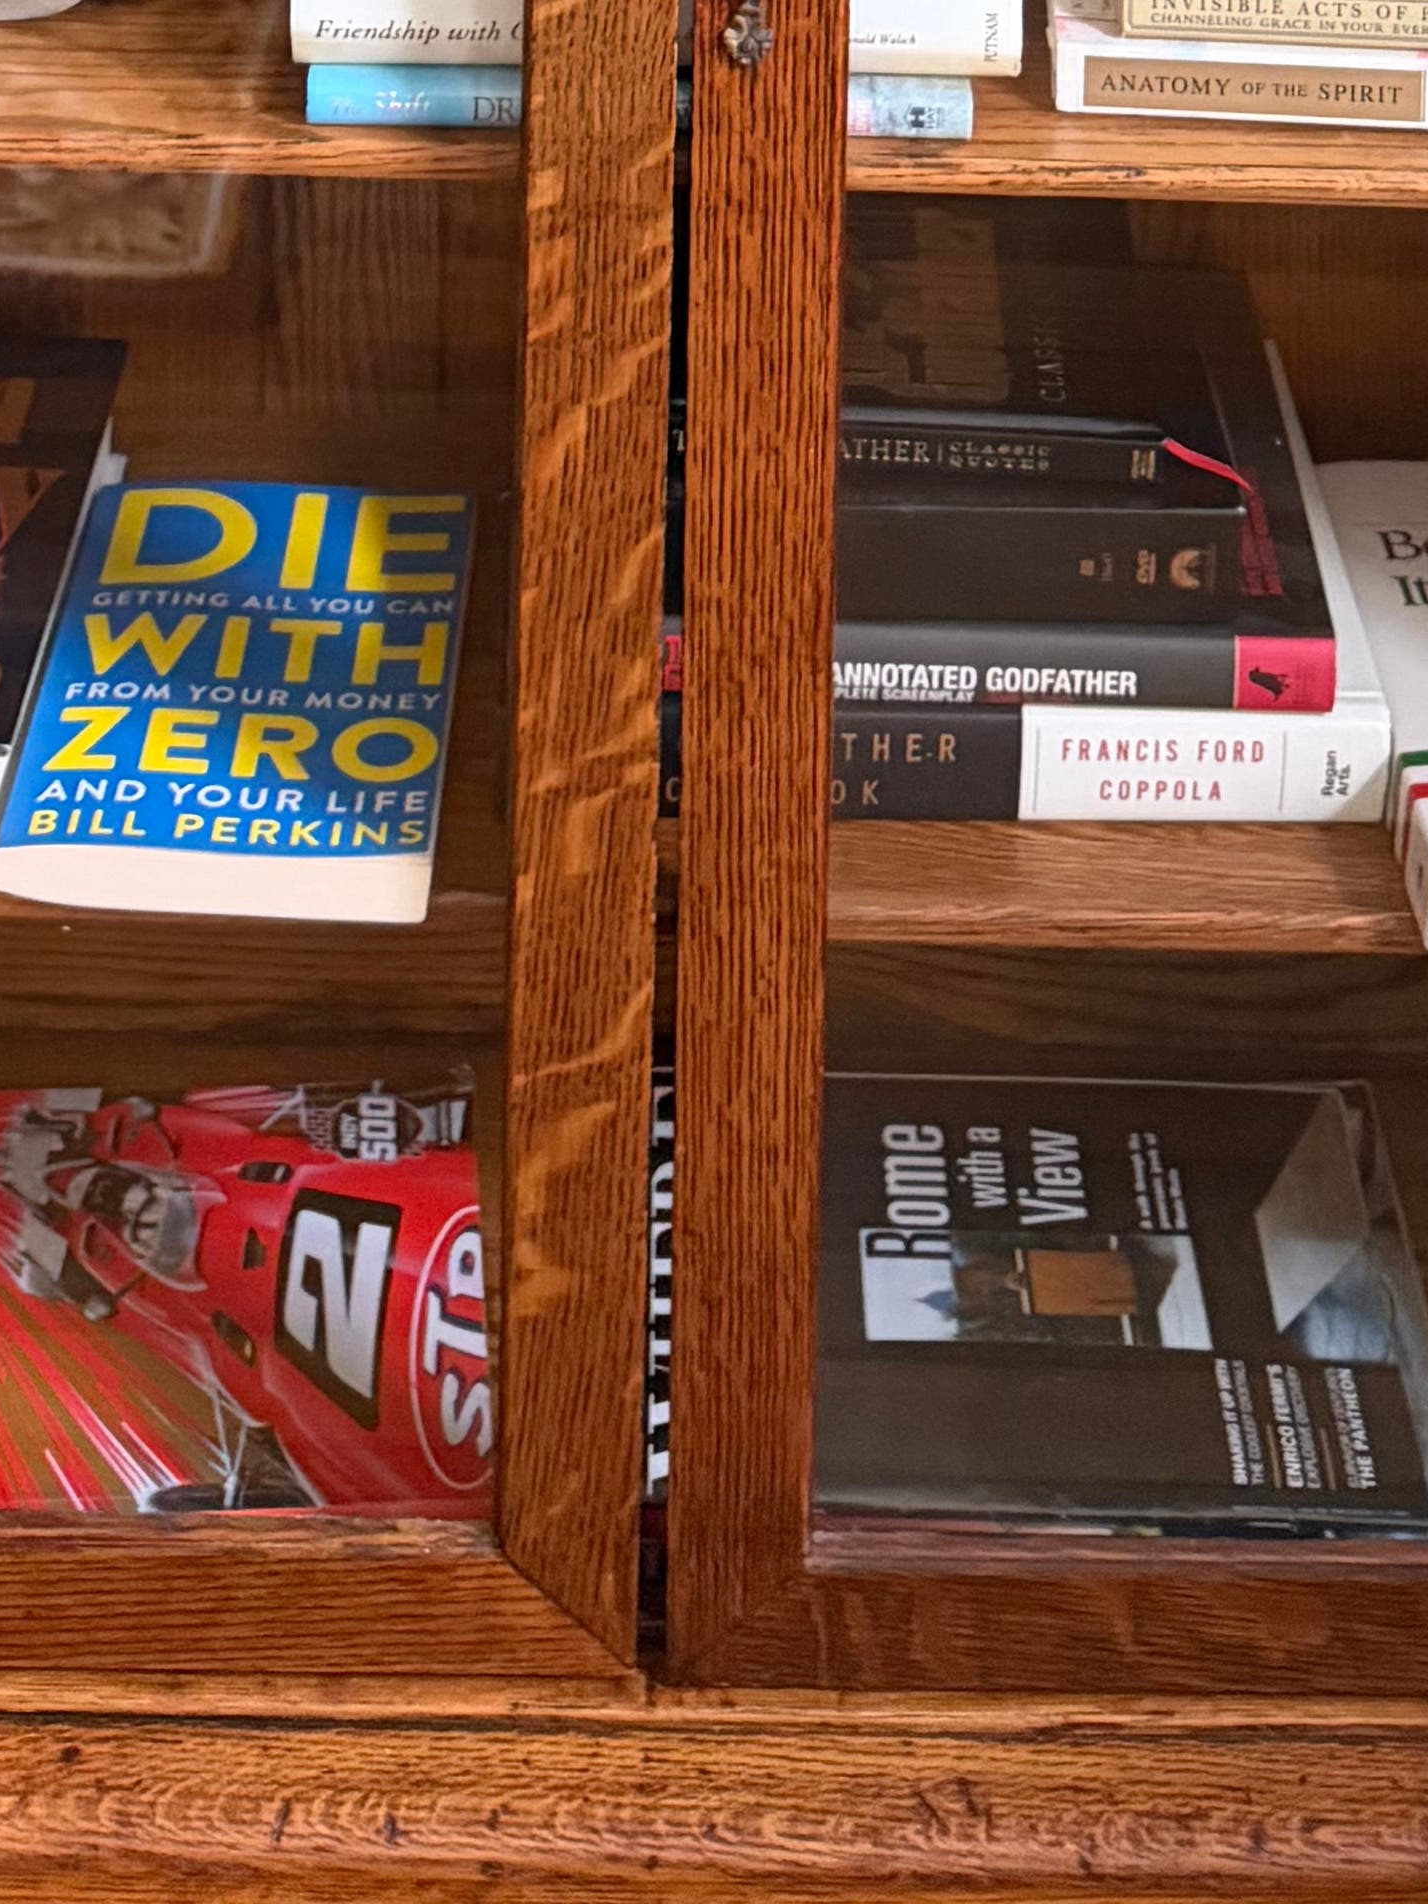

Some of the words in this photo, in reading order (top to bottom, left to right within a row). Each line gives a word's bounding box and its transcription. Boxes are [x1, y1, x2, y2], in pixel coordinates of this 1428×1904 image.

[1150, 12, 1254, 28] CHANNELING
[1259, 16, 1312, 31] GRACE
[1319, 18, 1336, 31] IN
[1340, 20, 1385, 34] YOUR
[1297, 0, 1362, 19] ACTS
[1375, 3, 1408, 21] OF
[315, 19, 440, 45] Friendship
[448, 20, 501, 41] with
[1100, 72, 1231, 96] ANATOMY
[1241, 80, 1267, 95] OF
[1270, 82, 1308, 97] THE
[1316, 83, 1405, 105] SPIRIT
[98, 487, 467, 592] DIE
[92, 590, 230, 609] GETTING
[241, 593, 300, 612] ALL
[309, 597, 375, 614] YOU
[386, 598, 455, 614] CAN
[83, 610, 450, 686] WITH
[64, 682, 171, 701] FROM
[187, 684, 291, 707] YOUR
[303, 689, 442, 712] MONEY
[833, 661, 977, 691] ANNOTATED
[985, 665, 1139, 698] GODFATHER
[881, 688, 976, 704] SCREENPLAY
[41, 706, 440, 783] ZERO
[1061, 738, 1179, 763] FRANCIS
[1196, 739, 1266, 764] FORD
[1099, 779, 1223, 802] COPPOLA
[1321, 750, 1338, 797] Regan
[35, 779, 148, 804] AND
[167, 782, 305, 813] YOUR
[325, 790, 429, 813] LIFE
[27, 809, 148, 837] BILL
[173, 815, 427, 847] PERKINS
[339, 1112, 360, 1150] INDY
[358, 1093, 399, 1163] 500
[968, 1125, 1000, 1145] a
[866, 1122, 952, 1261] Rome
[957, 1148, 1009, 1211] with
[1016, 1126, 1089, 1227] View
[283, 1208, 393, 1400] 2
[422, 1232, 493, 1458] STP
[1337, 1367, 1370, 1453] PANTHEON
[1277, 1425, 1305, 1489] ENRICO
[1358, 1455, 1378, 1489] THE
